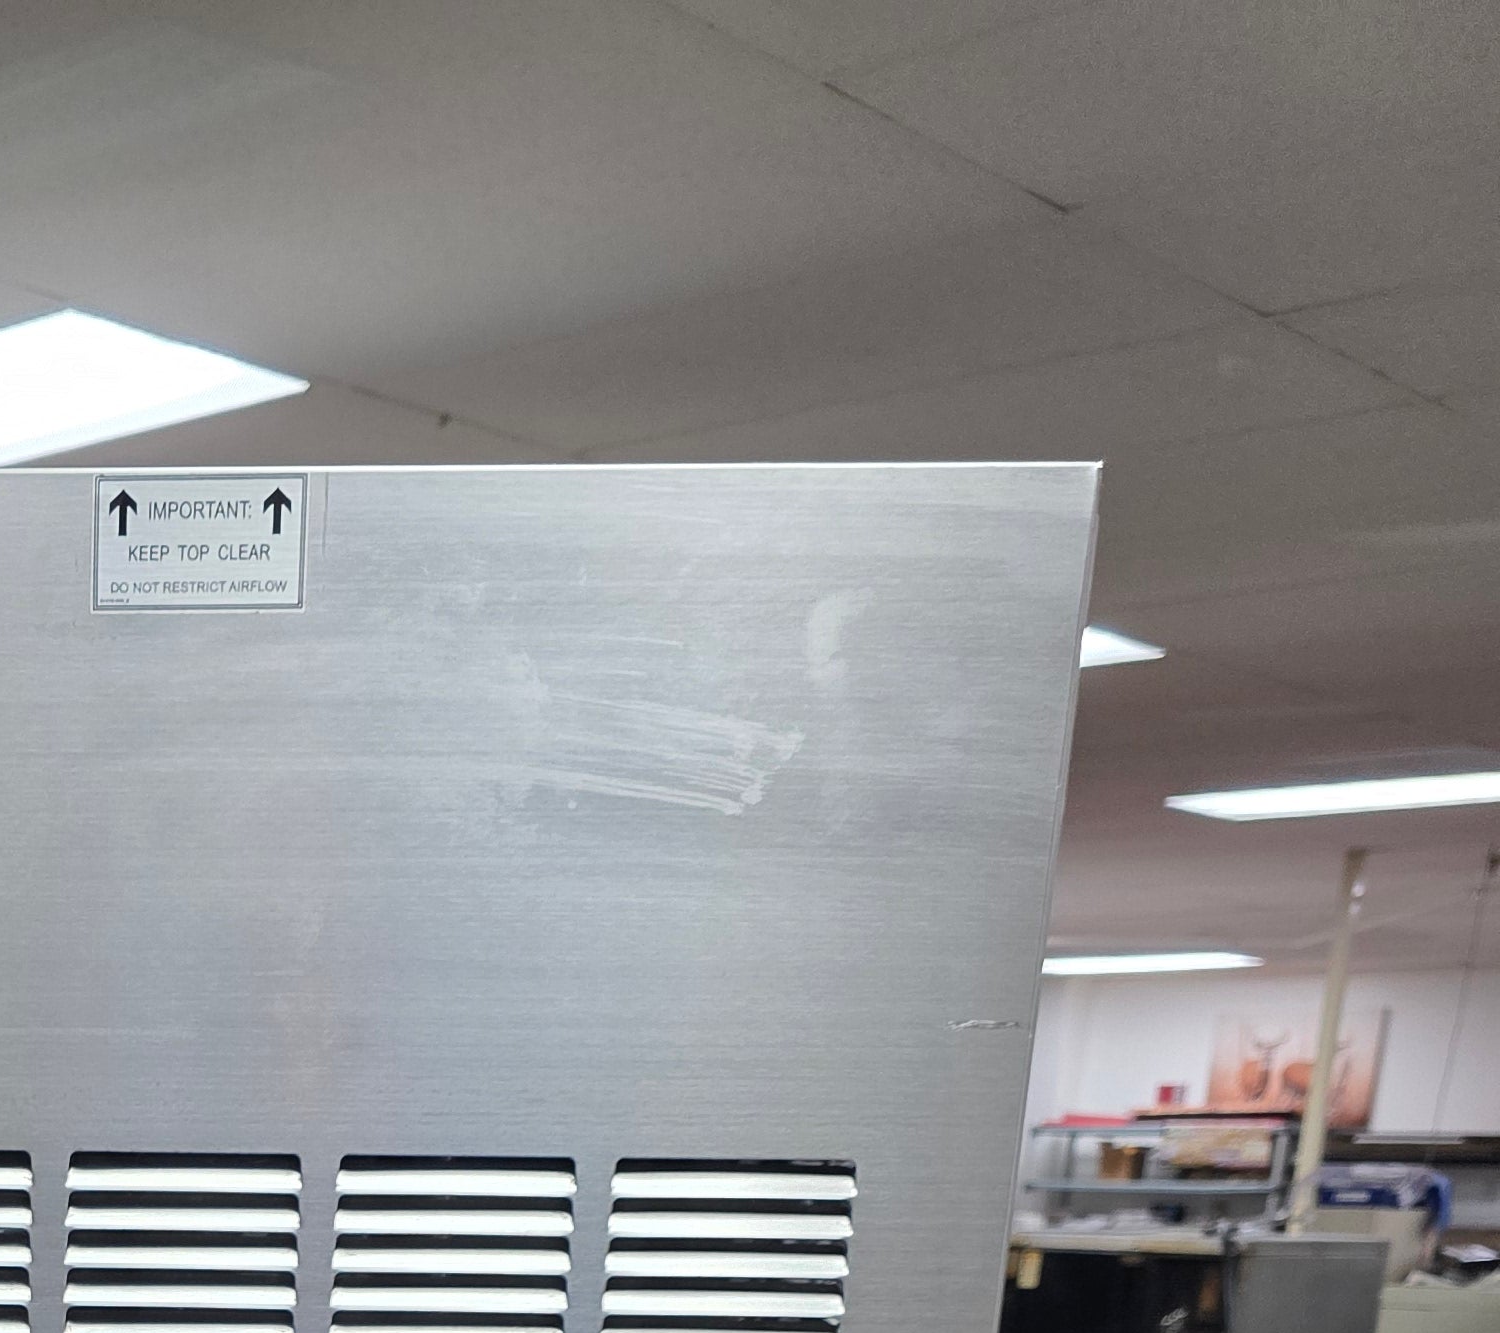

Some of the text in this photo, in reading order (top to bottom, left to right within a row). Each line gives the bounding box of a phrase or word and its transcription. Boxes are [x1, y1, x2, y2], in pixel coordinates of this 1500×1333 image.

[148, 500, 252, 521] IMPORTANT:
[128, 544, 271, 562] KEEP TOP CLEAR
[110, 580, 288, 594] DO NOT RESTRICT AIRFLOW
